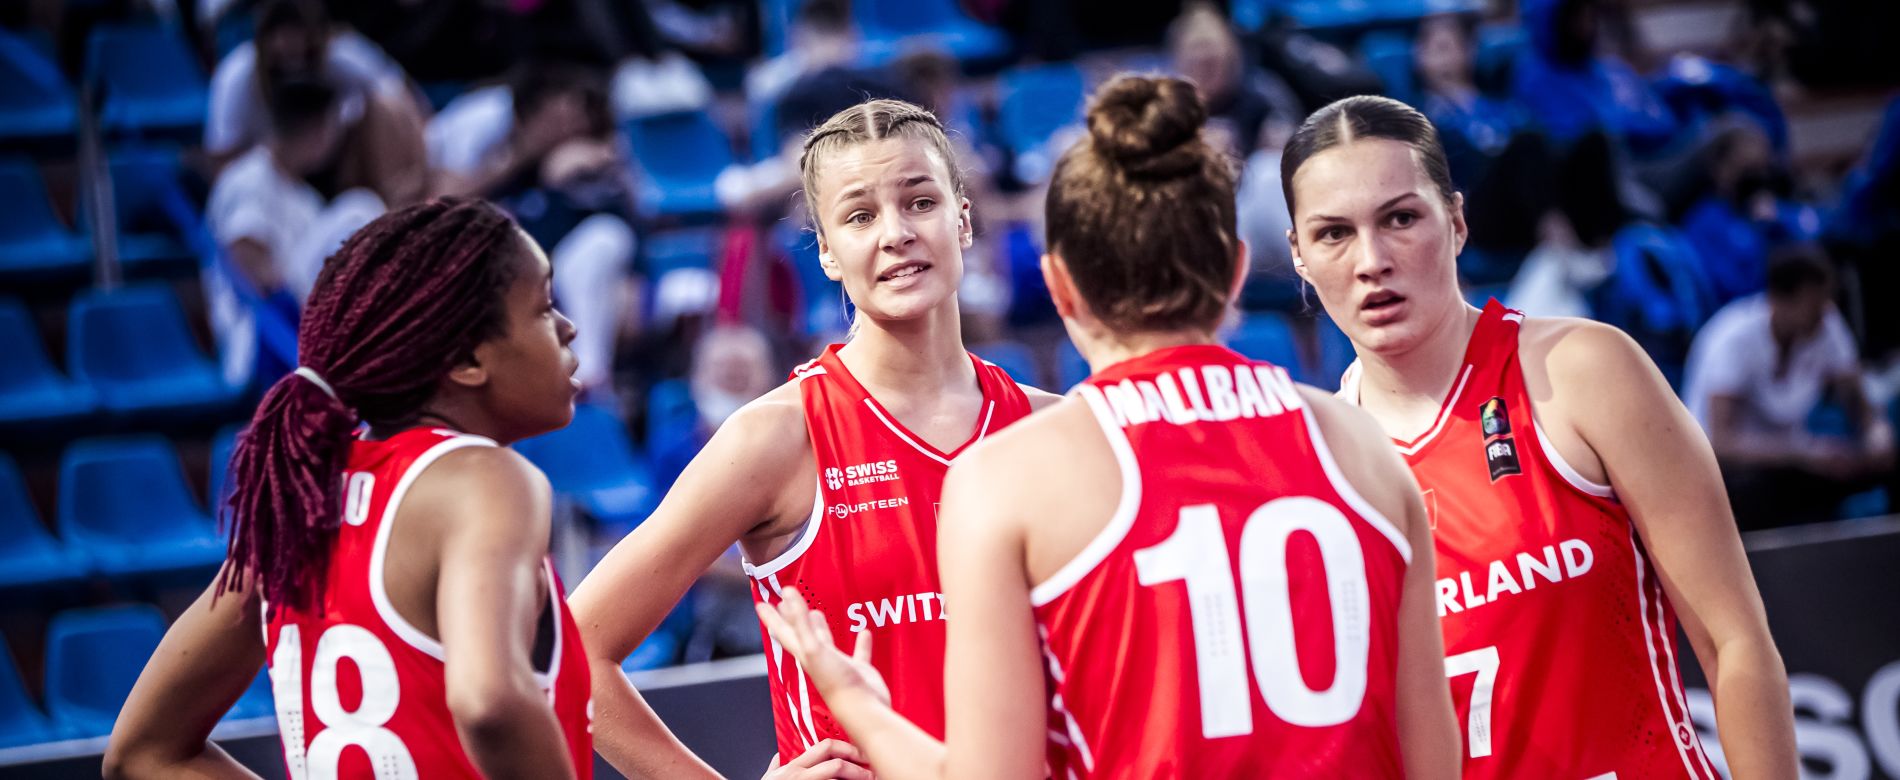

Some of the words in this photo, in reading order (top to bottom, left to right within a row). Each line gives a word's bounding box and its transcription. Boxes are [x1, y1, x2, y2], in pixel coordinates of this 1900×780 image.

[845, 459, 898, 479] SWISS
[847, 473, 900, 487] BASKETBALL
[828, 496, 909, 519] FOURTEEN
[1133, 495, 1371, 739] 10
[268, 623, 420, 780] 18
[1443, 645, 1500, 758] 7
